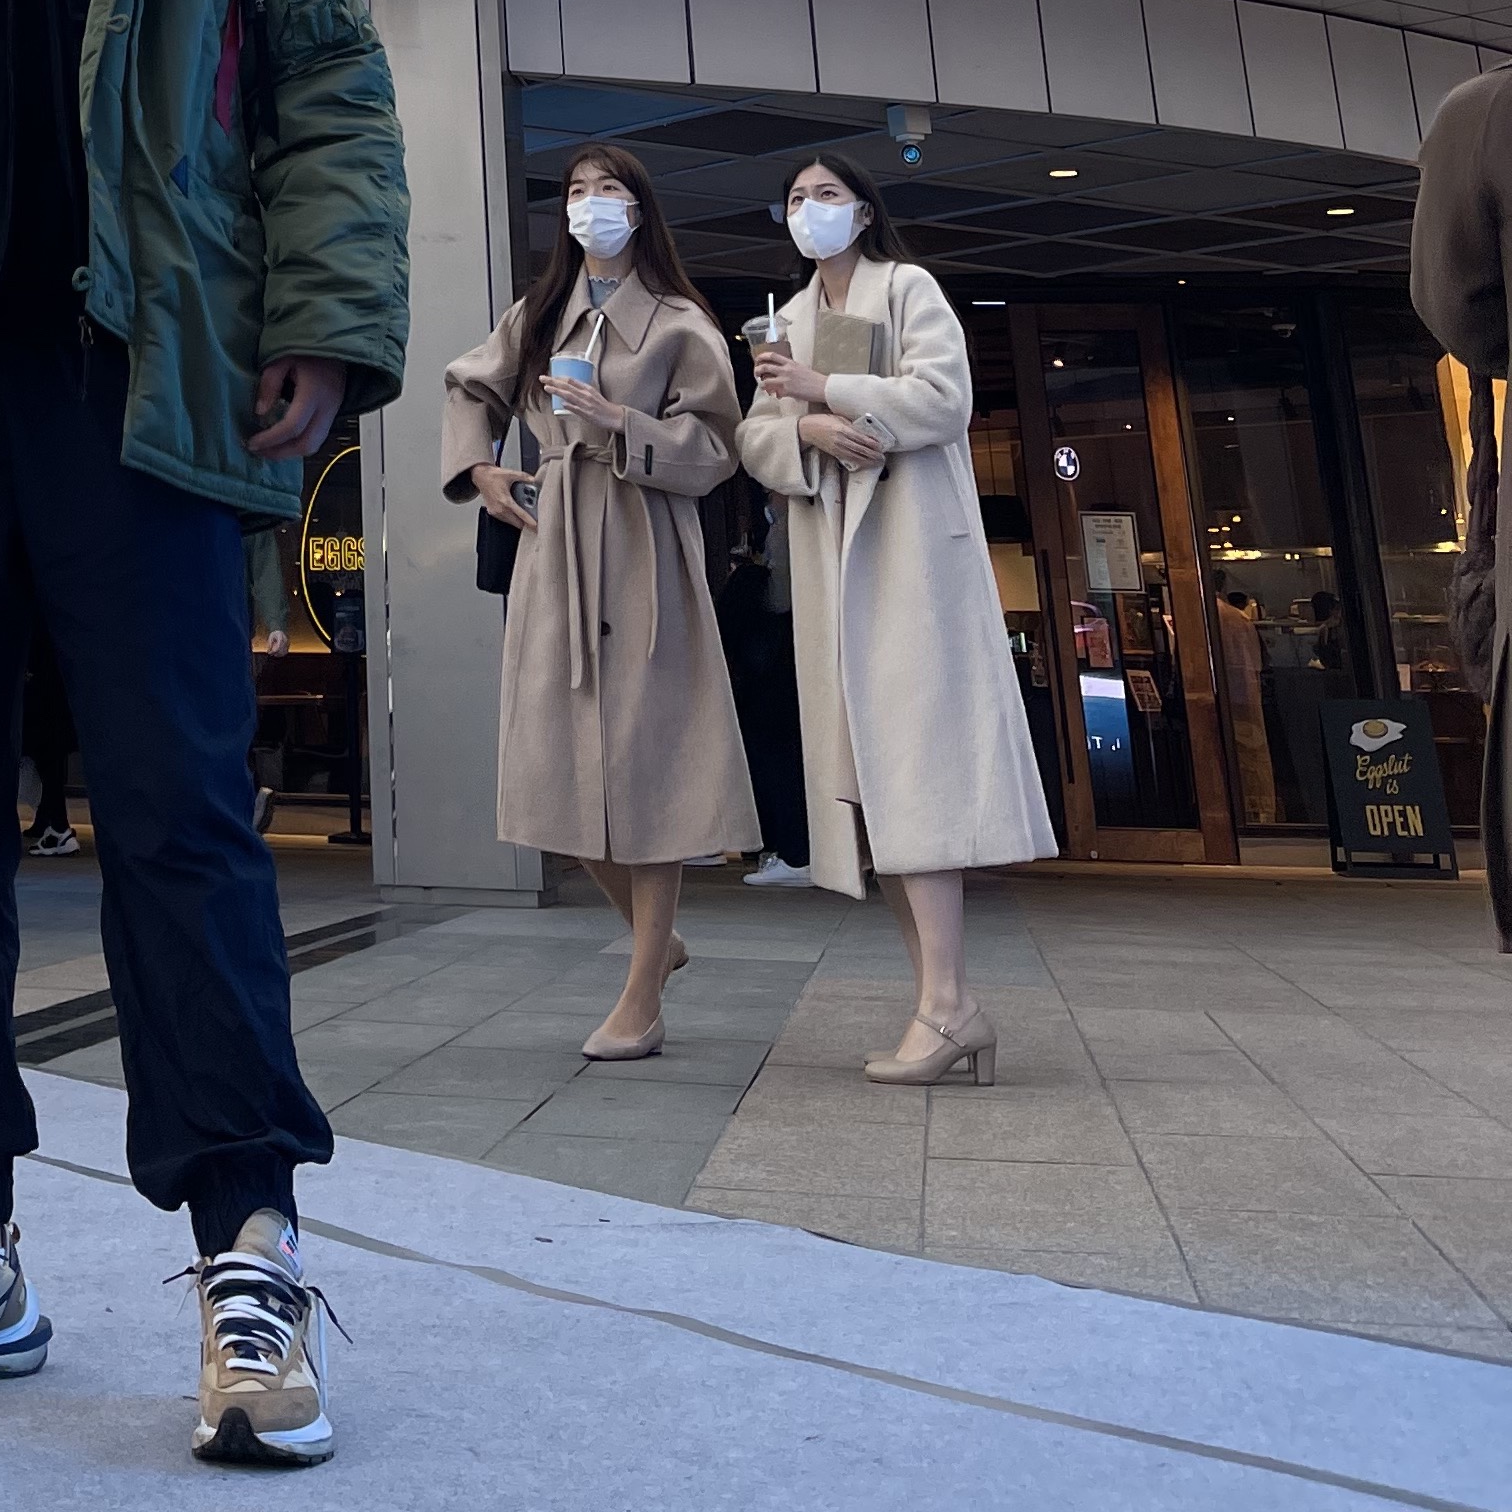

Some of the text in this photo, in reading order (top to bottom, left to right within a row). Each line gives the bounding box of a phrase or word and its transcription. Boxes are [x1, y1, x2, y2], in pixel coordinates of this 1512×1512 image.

[1355, 752, 1413, 790] Eggslut
[1386, 778, 1399, 795] is
[1364, 804, 1424, 837] OPEN
